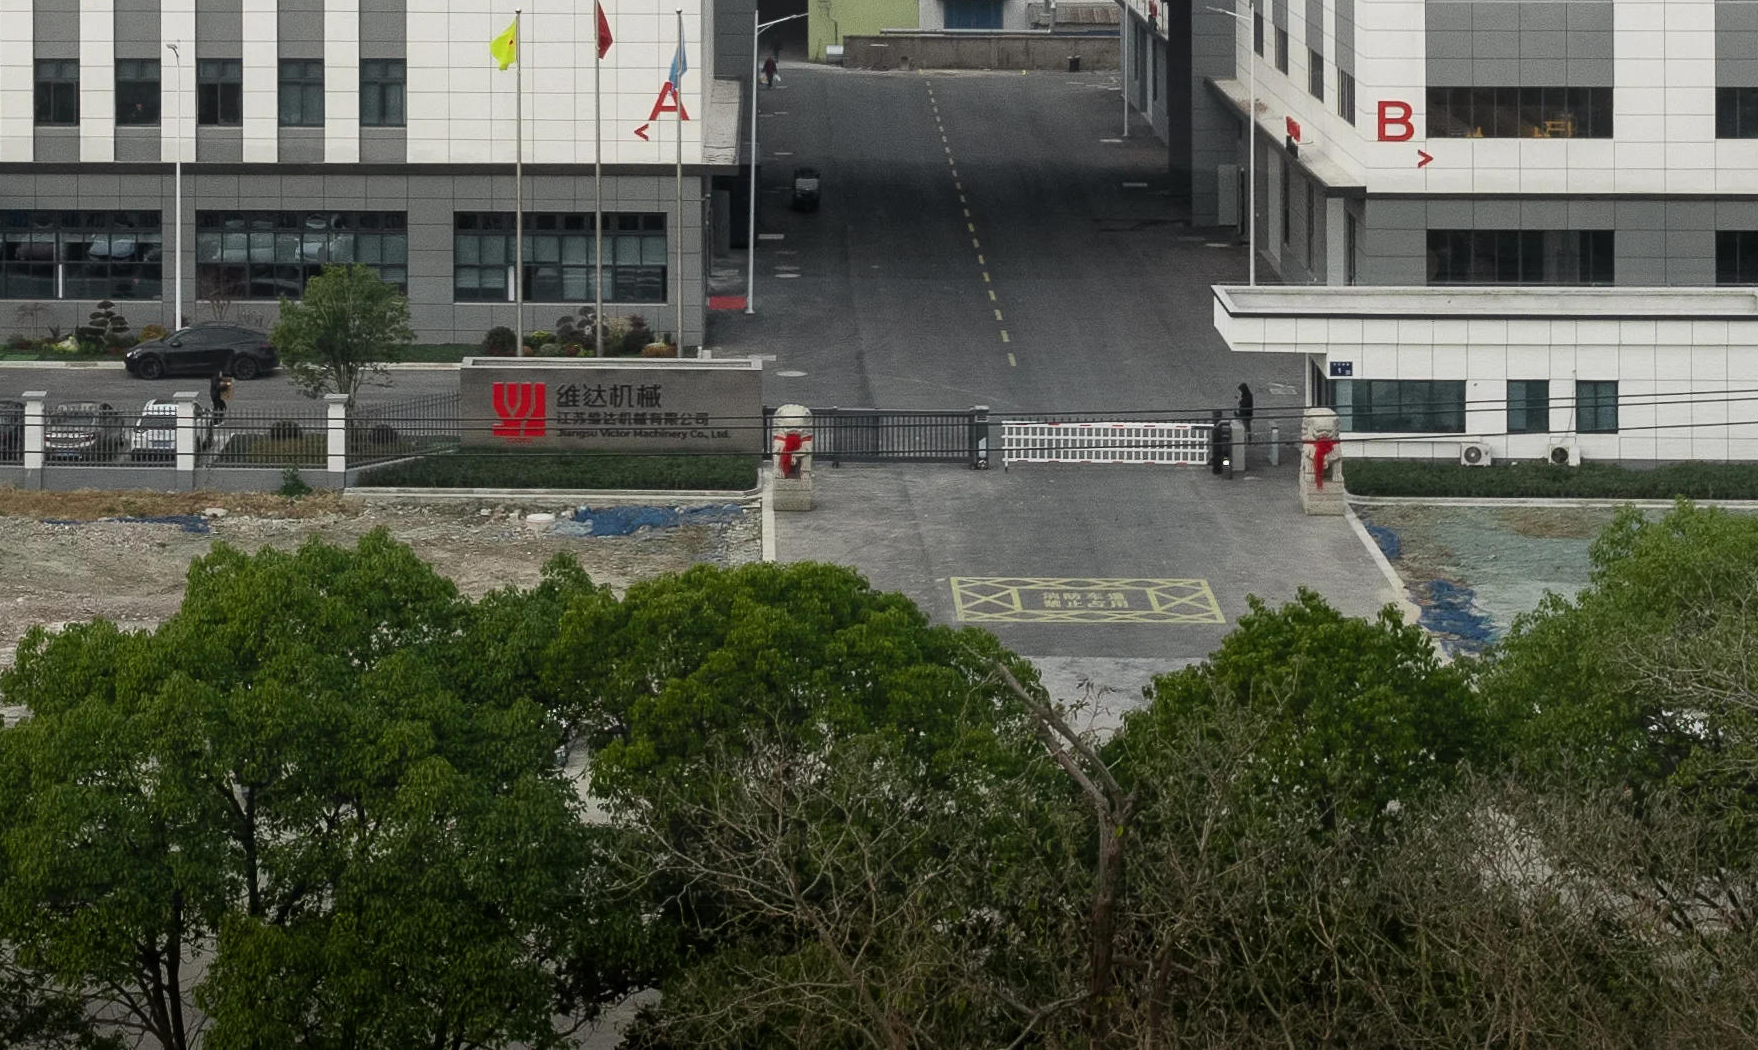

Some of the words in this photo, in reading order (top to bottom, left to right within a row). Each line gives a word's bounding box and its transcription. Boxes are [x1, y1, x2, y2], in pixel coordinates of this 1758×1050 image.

[648, 81, 690, 121] A
[1377, 100, 1415, 142] B
[556, 383, 662, 408] 维达机械
[556, 411, 709, 426] 江苏维达机械有限公司
[557, 429, 598, 440] Jiangsu
[600, 429, 631, 438] Victor
[633, 429, 686, 440] Machinery
[711, 429, 731, 439] Ltd.
